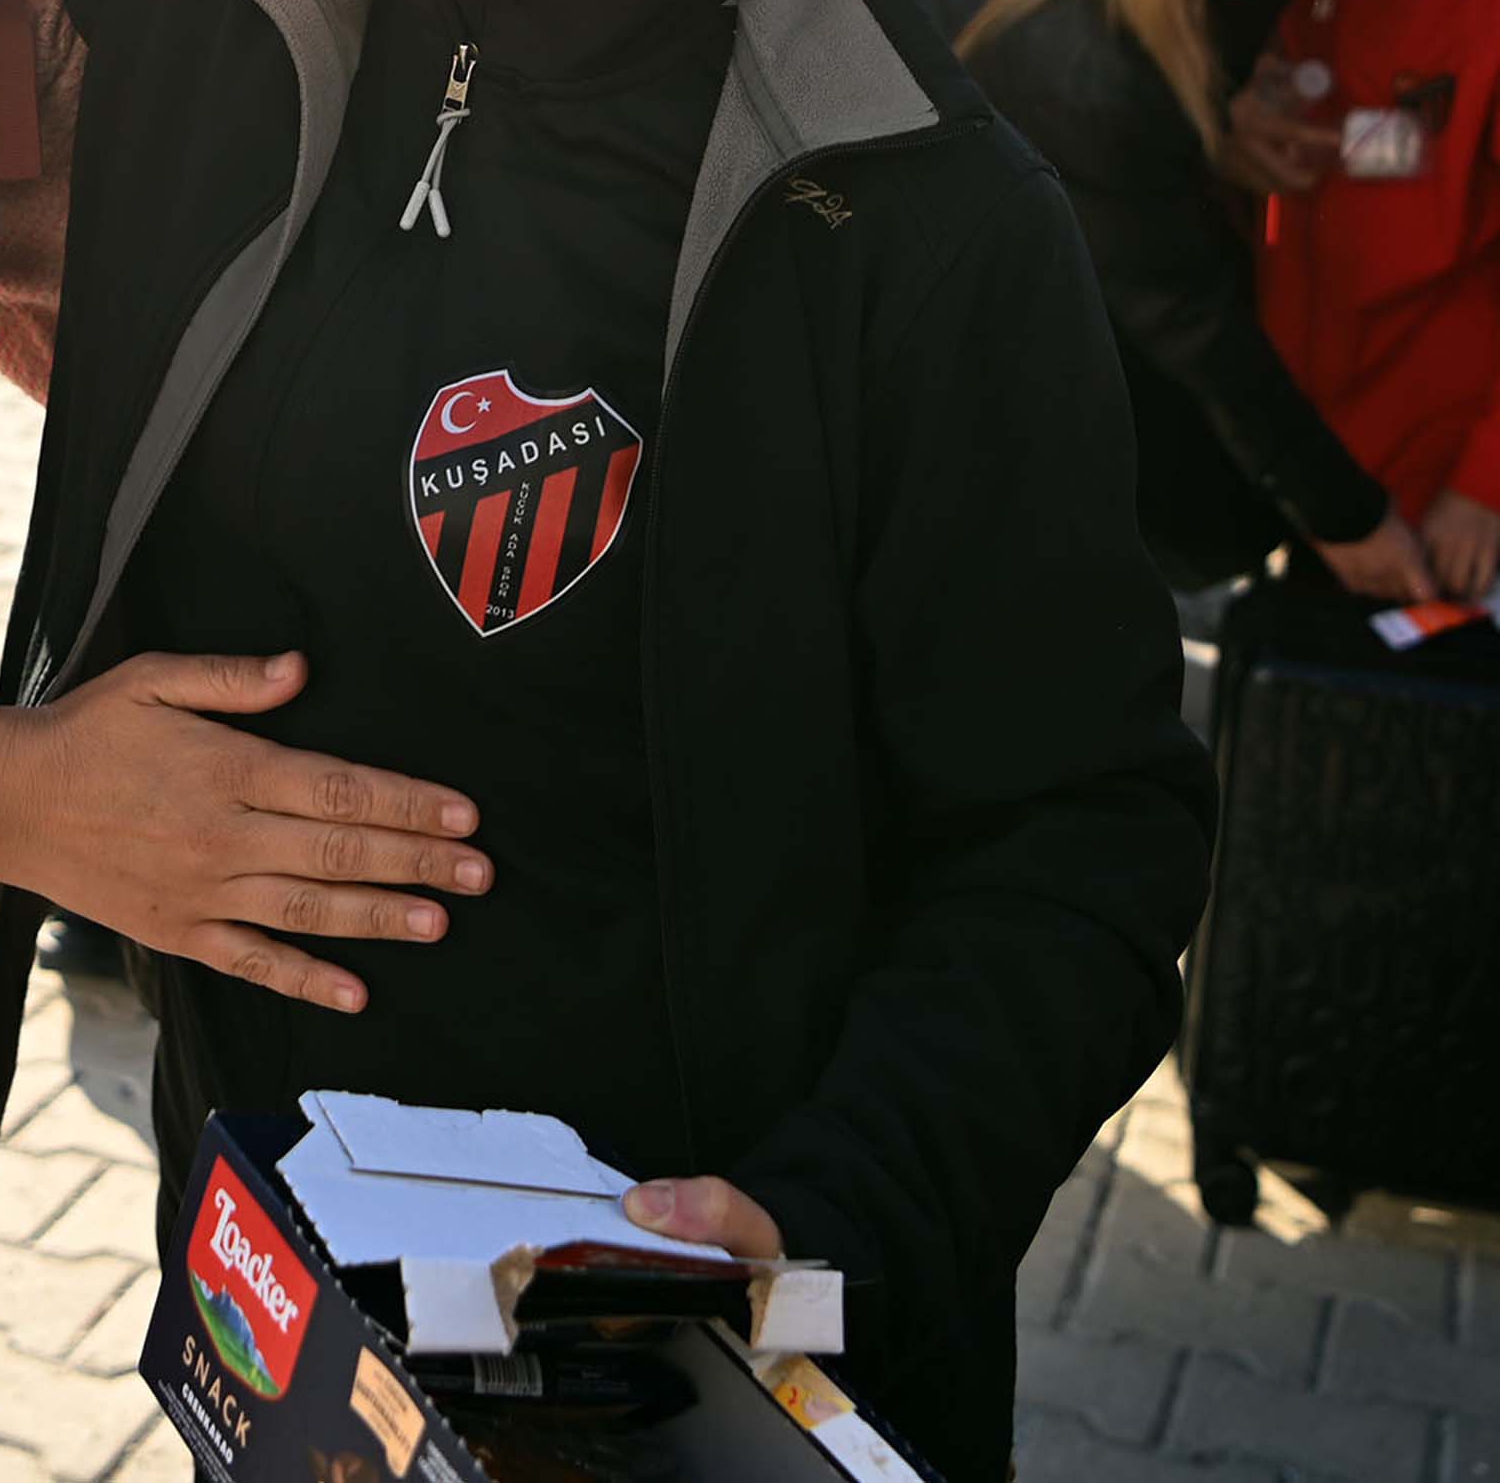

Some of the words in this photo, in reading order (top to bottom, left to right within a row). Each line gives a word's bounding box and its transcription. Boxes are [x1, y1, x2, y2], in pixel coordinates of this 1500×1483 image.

[421, 416, 606, 497] KUŞADASI
[506, 533, 519, 558] ADA
[486, 605, 515, 619] 2013
[210, 1188, 299, 1334] Loacker
[182, 1335, 252, 1448] SNACK
